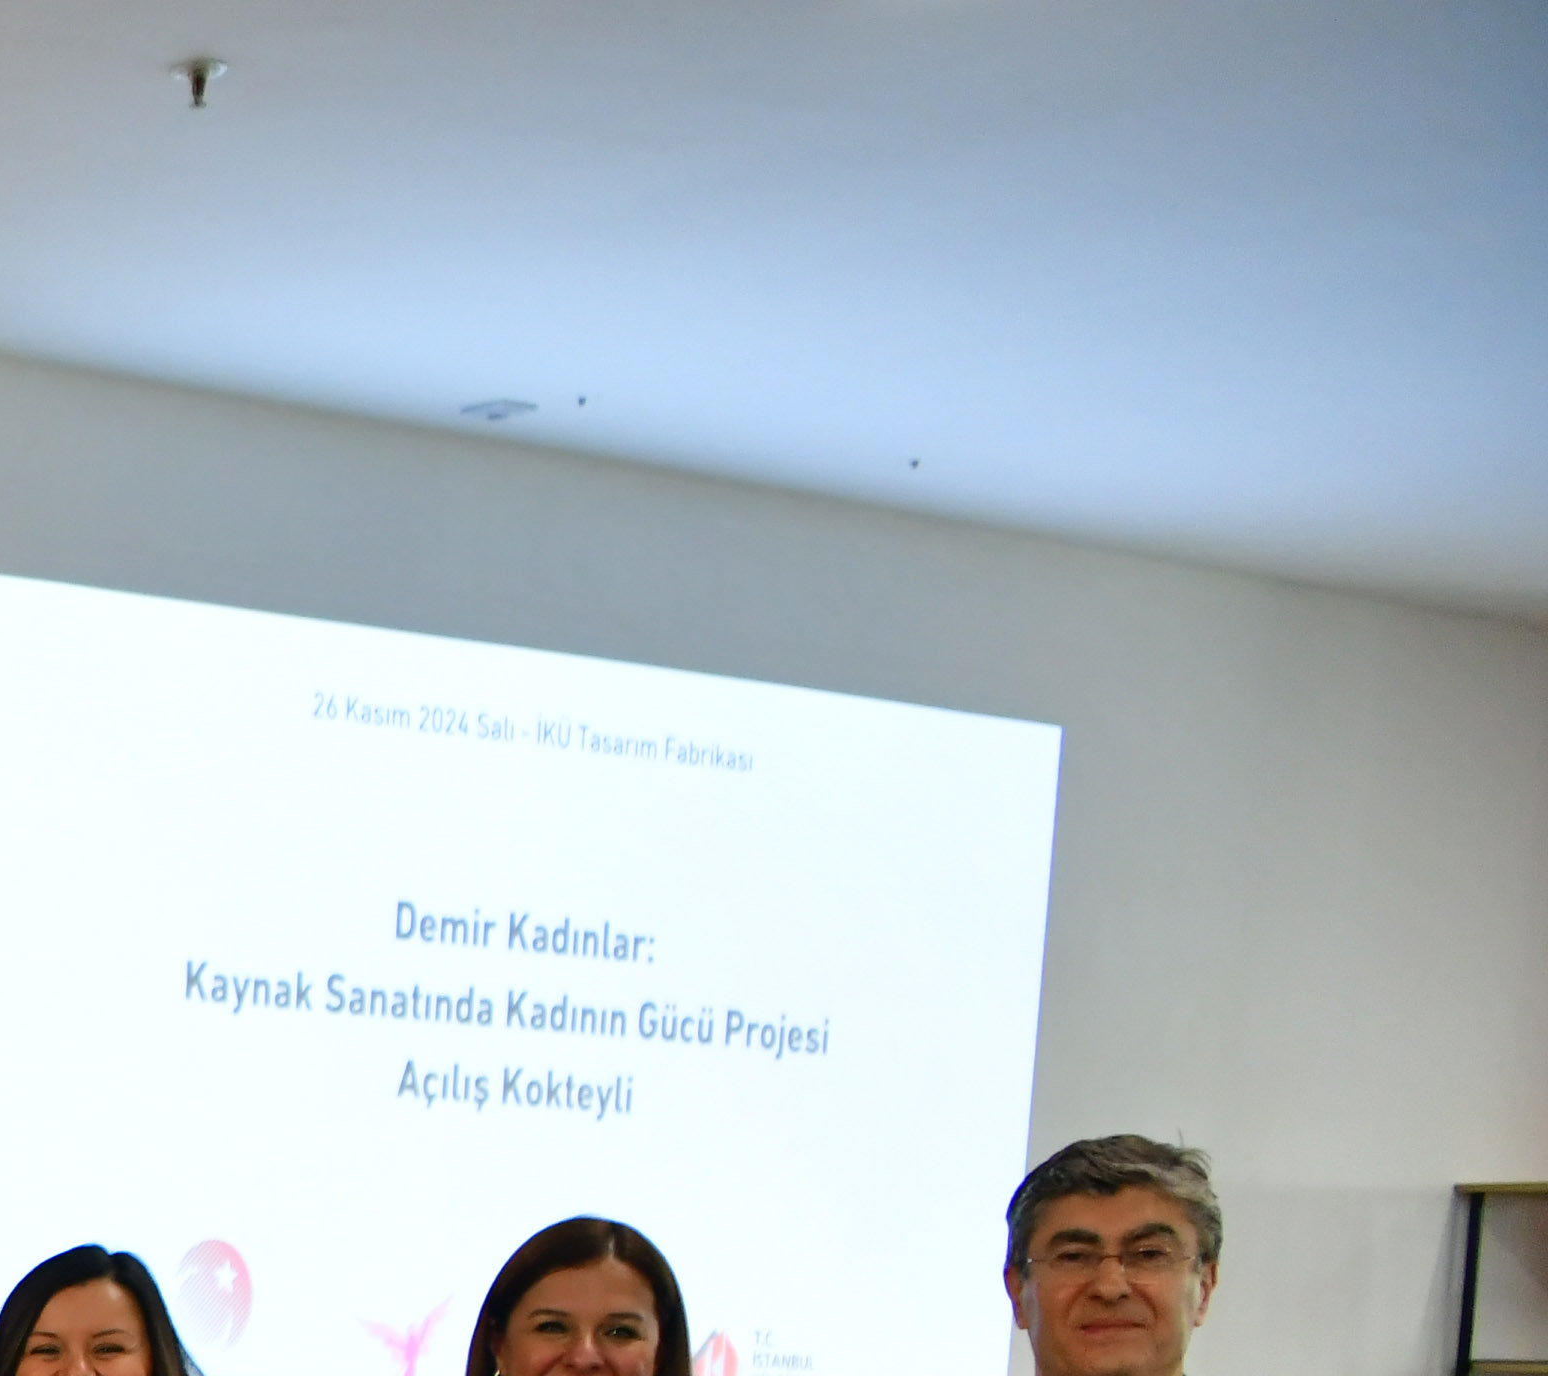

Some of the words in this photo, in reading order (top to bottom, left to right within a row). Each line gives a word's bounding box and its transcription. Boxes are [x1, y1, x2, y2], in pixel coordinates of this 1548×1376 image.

[313, 690, 338, 720] 26
[346, 695, 411, 728] Kasım
[418, 704, 469, 736] 2024
[477, 711, 515, 742] Salı
[579, 723, 657, 760] Tasarım
[664, 735, 754, 772] Fabrikası
[396, 900, 497, 947] Demir
[507, 912, 655, 963] Kadınlar:
[185, 960, 314, 1014] Kaynak
[325, 972, 494, 1026] Sanatında
[506, 989, 627, 1037] Kadının
[638, 1001, 714, 1044] Gücü
[724, 1009, 830, 1060] Projesi
[397, 1059, 489, 1112] Açılış
[502, 1066, 634, 1121] Kokteyli
